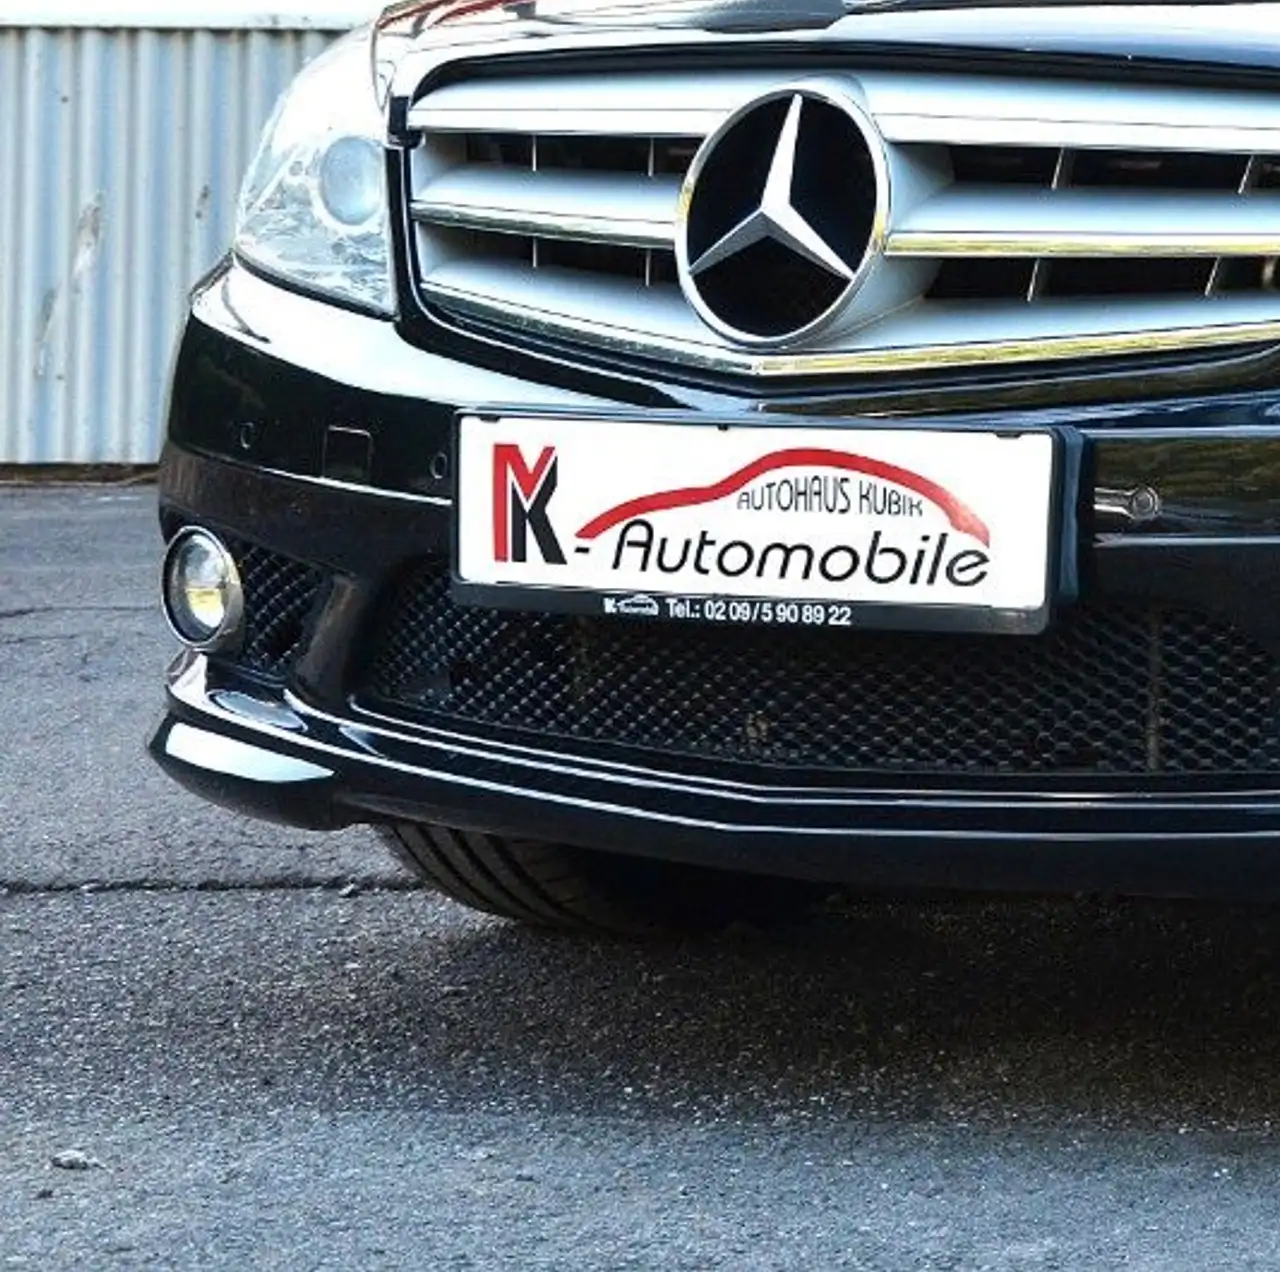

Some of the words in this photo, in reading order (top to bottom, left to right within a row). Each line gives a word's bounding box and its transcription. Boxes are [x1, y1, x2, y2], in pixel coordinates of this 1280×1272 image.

[737, 475, 851, 514] AUTOHAUS
[859, 480, 923, 517] KUBIK
[665, 598, 701, 618] Tel.:
